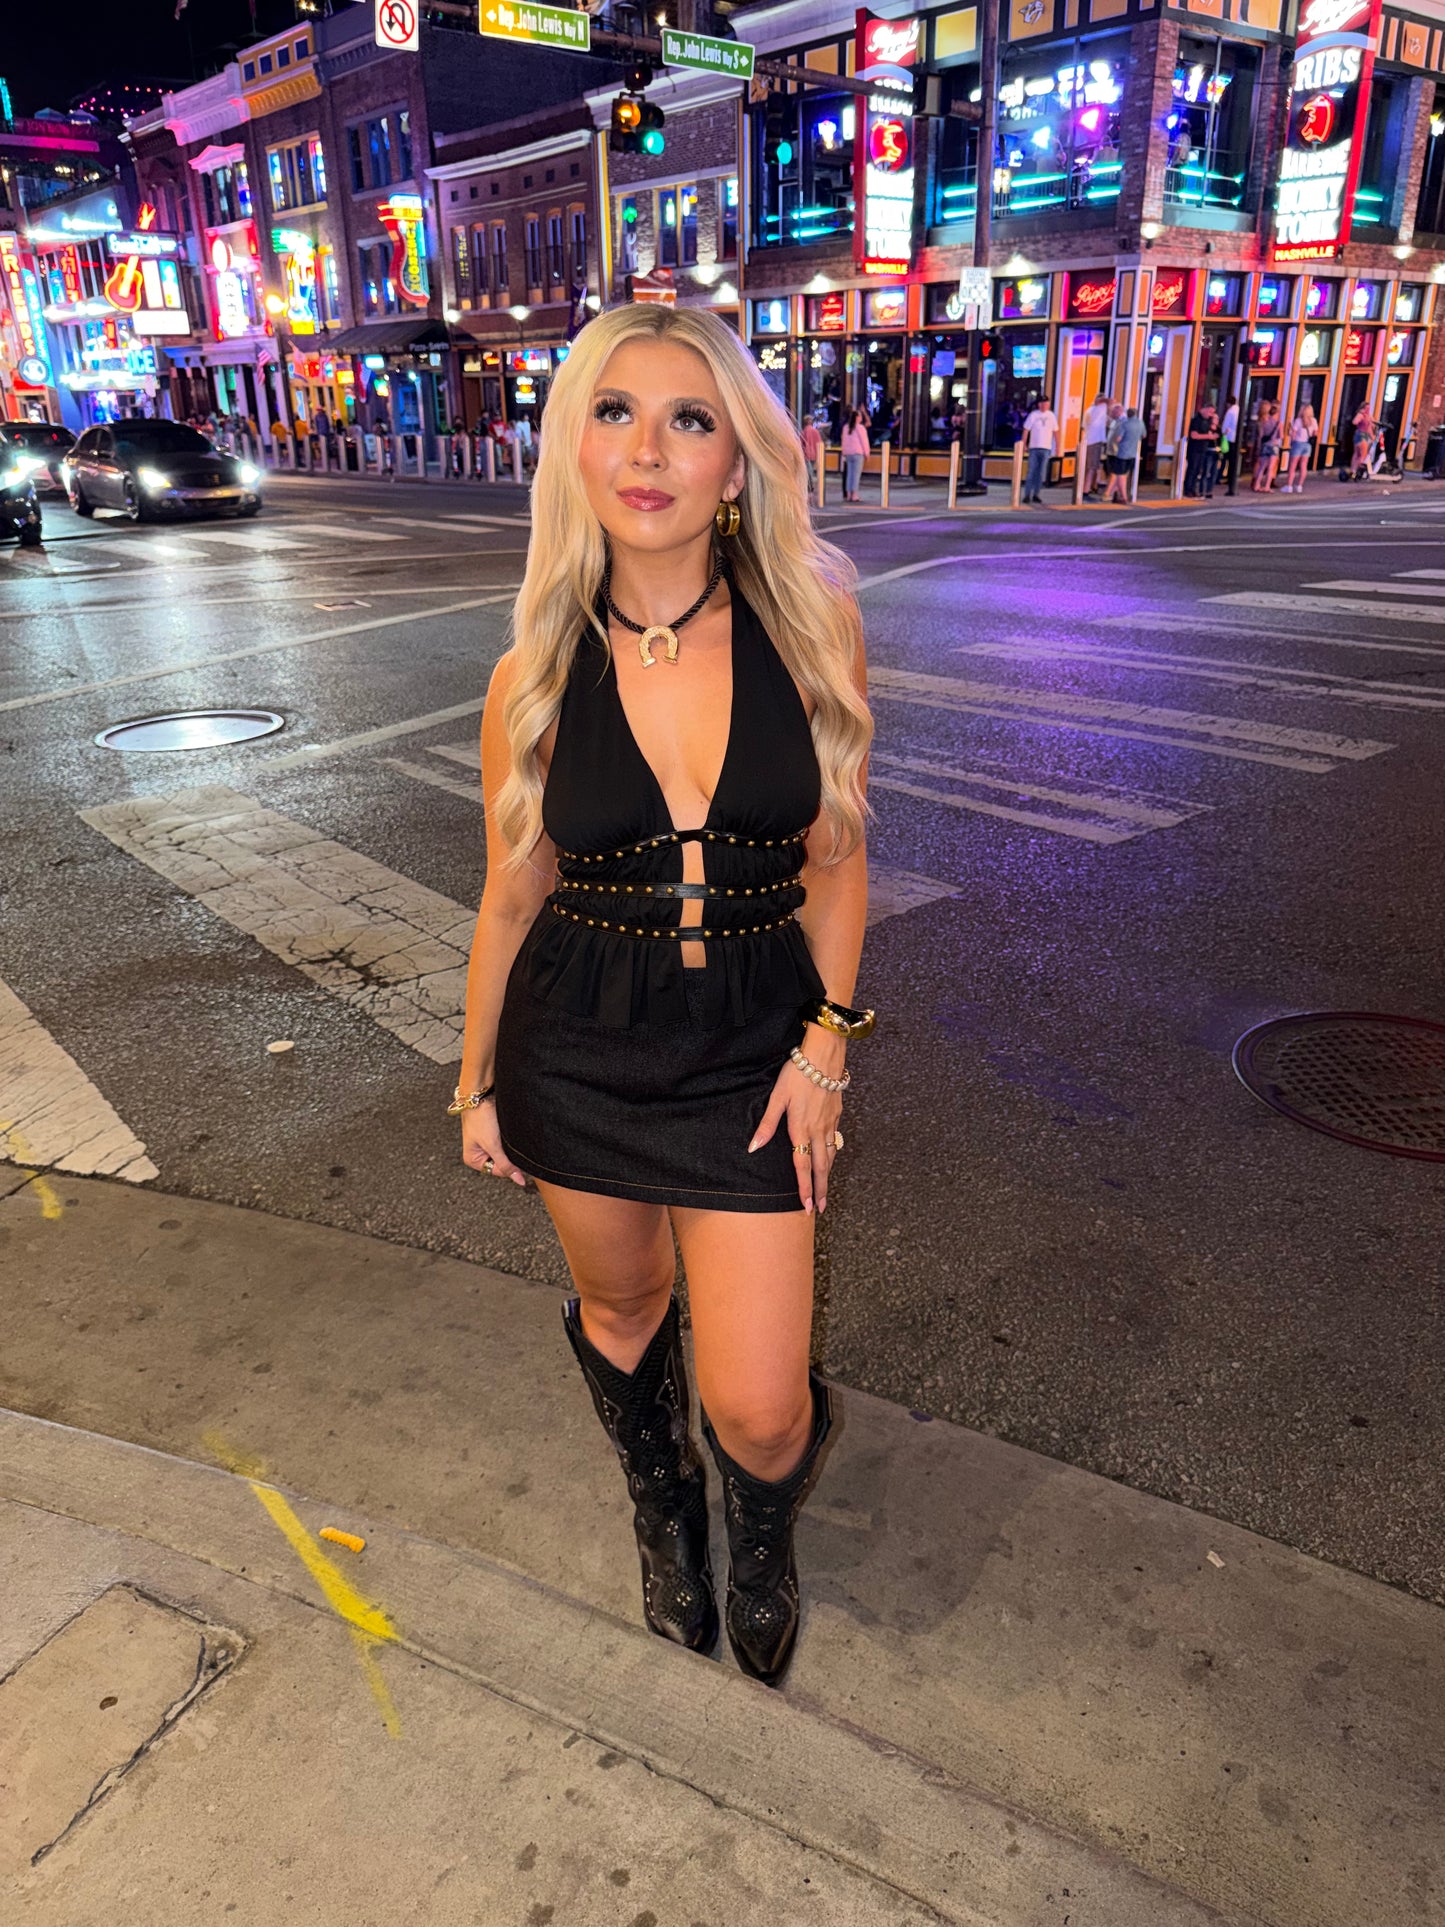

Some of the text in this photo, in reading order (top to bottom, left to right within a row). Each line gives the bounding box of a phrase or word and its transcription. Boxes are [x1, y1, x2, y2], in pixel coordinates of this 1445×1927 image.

[497, 3, 585, 42] Rep. John Lewis Way N
[666, 34, 740, 69] Rep. John Lewis Way S
[1293, 48, 1361, 91] RIBS
[1274, 245, 1336, 262] NASHVILLE
[0, 237, 36, 356] FRIENDS
